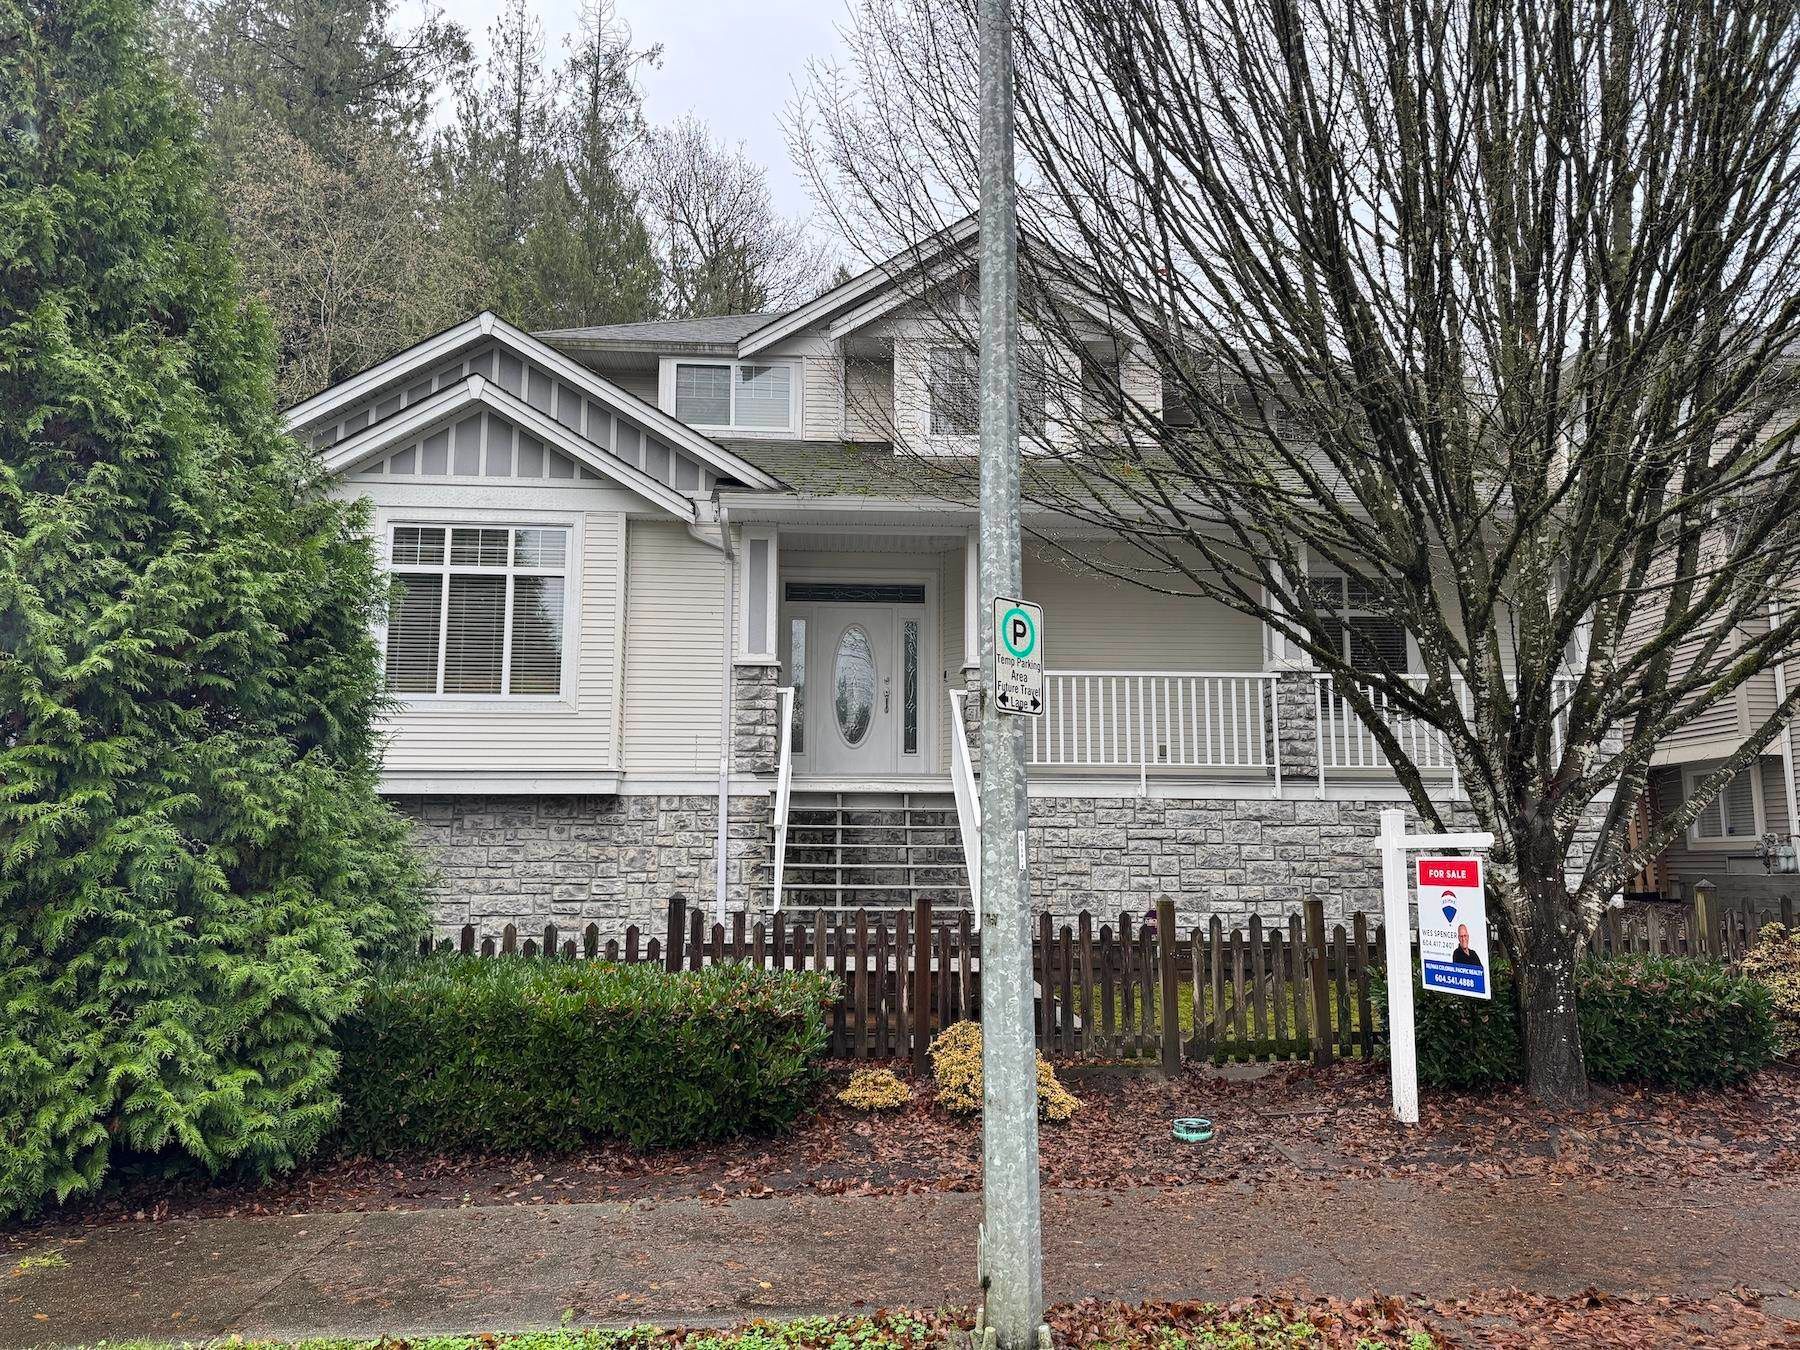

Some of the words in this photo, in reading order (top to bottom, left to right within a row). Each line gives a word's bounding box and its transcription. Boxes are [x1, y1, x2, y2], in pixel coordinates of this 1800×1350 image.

[1013, 619, 1027, 645] P
[997, 653, 1015, 667] Temp
[1016, 657, 1040, 674] Parking
[1011, 669, 1028, 682] Area
[997, 680, 1019, 694] Future
[1020, 683, 1041, 697] Travel
[1010, 696, 1028, 710] Lane
[1428, 869, 1445, 878] FOR
[1446, 869, 1467, 879] SALE
[1422, 929, 1434, 937] WES
[1434, 930, 1457, 939] SPENCER
